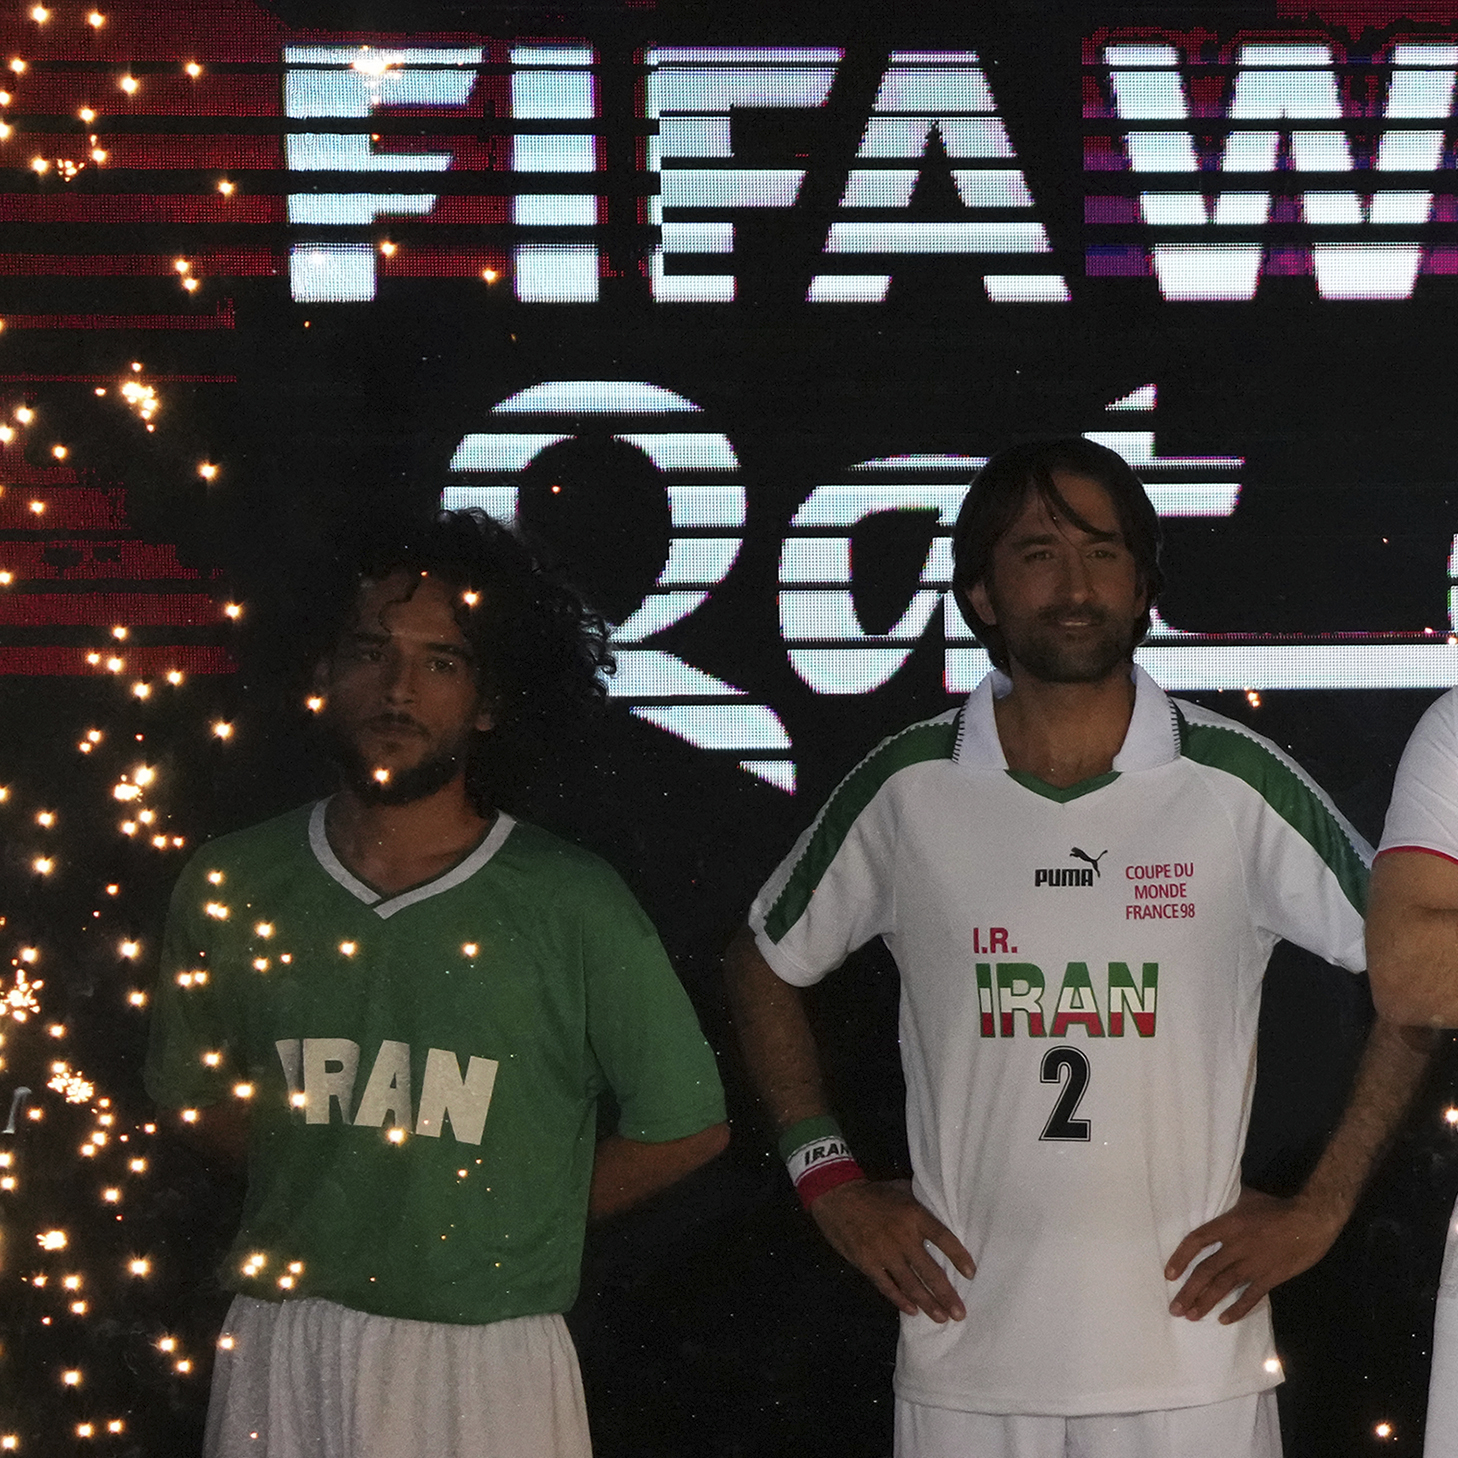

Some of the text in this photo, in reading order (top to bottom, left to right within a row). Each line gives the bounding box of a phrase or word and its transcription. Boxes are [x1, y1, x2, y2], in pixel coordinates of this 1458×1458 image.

[284, 43, 1070, 303] FIFA
[1034, 868, 1094, 887] PUMA
[1125, 862, 1194, 880] COUPE DU
[1134, 883, 1187, 899] MONDE
[1126, 903, 1195, 920] FRANCE 98
[973, 927, 1018, 954] I.R.
[975, 962, 1159, 1038] IRAN
[275, 1038, 499, 1145] IRAN
[1038, 1045, 1091, 1142] 2
